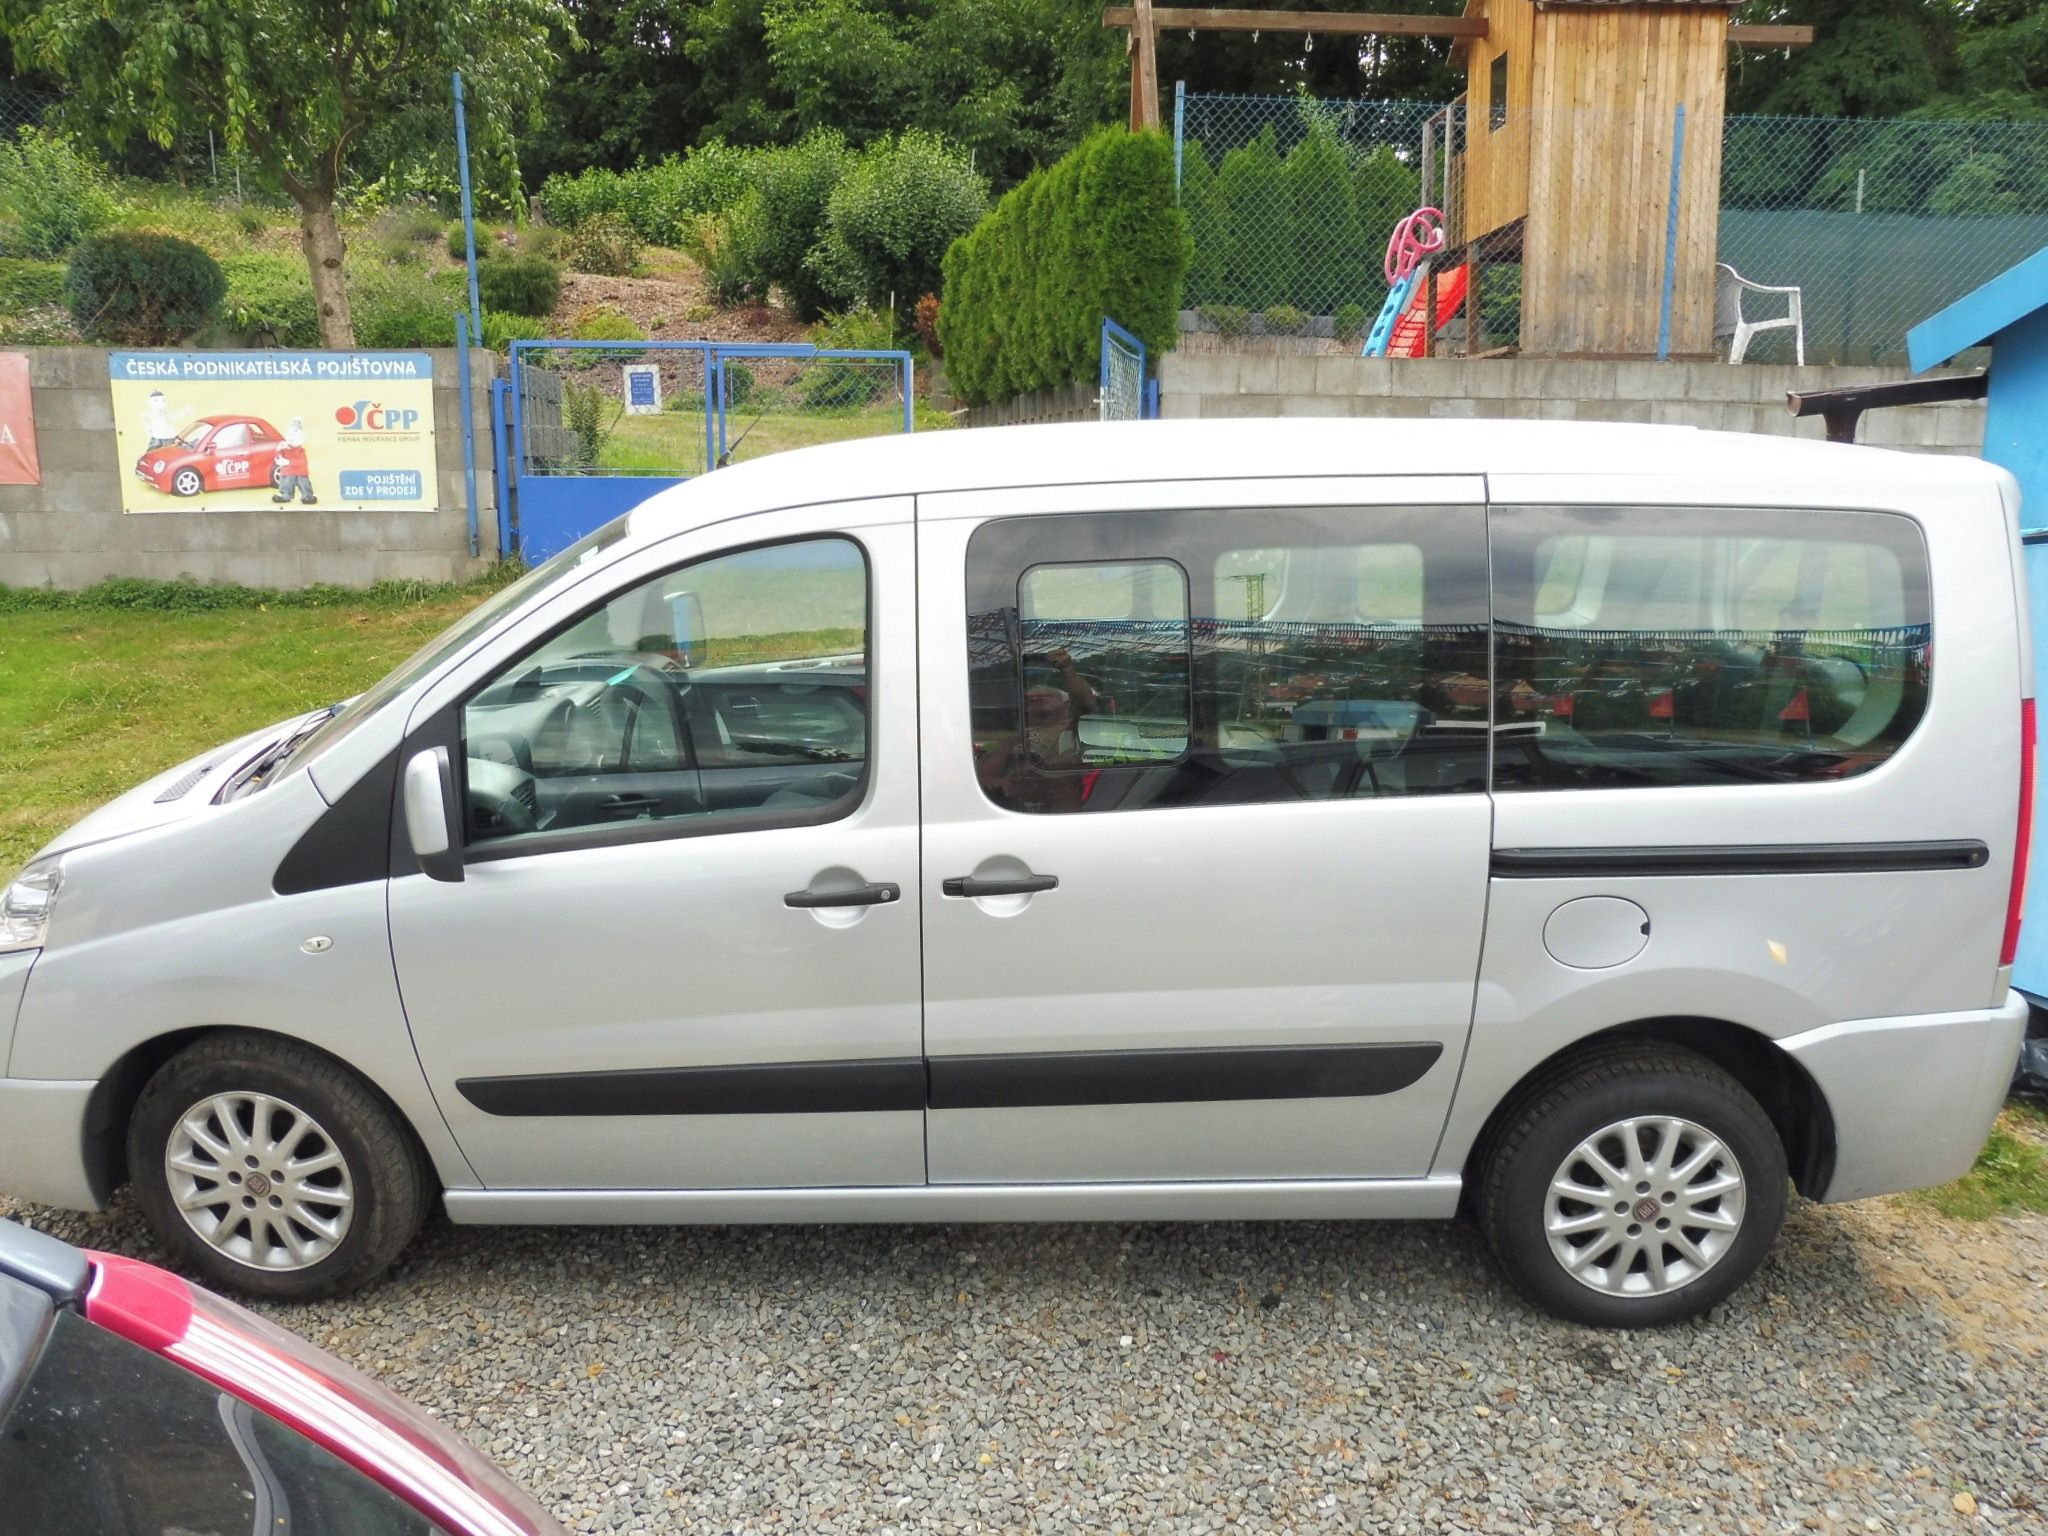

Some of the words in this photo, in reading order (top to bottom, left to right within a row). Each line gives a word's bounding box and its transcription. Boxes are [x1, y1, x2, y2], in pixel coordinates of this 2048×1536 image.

[126, 358, 178, 375] ČESKÁ
[183, 358, 313, 375] PODNIKATELSKÁ
[317, 358, 417, 375] POJIŠŤOVNA
[367, 403, 418, 430] ČPP
[367, 472, 416, 485] POJIŠTĚNÍ
[344, 486, 364, 495] ZDE
[366, 486, 375, 495] V
[376, 486, 417, 496] PRODEJI
